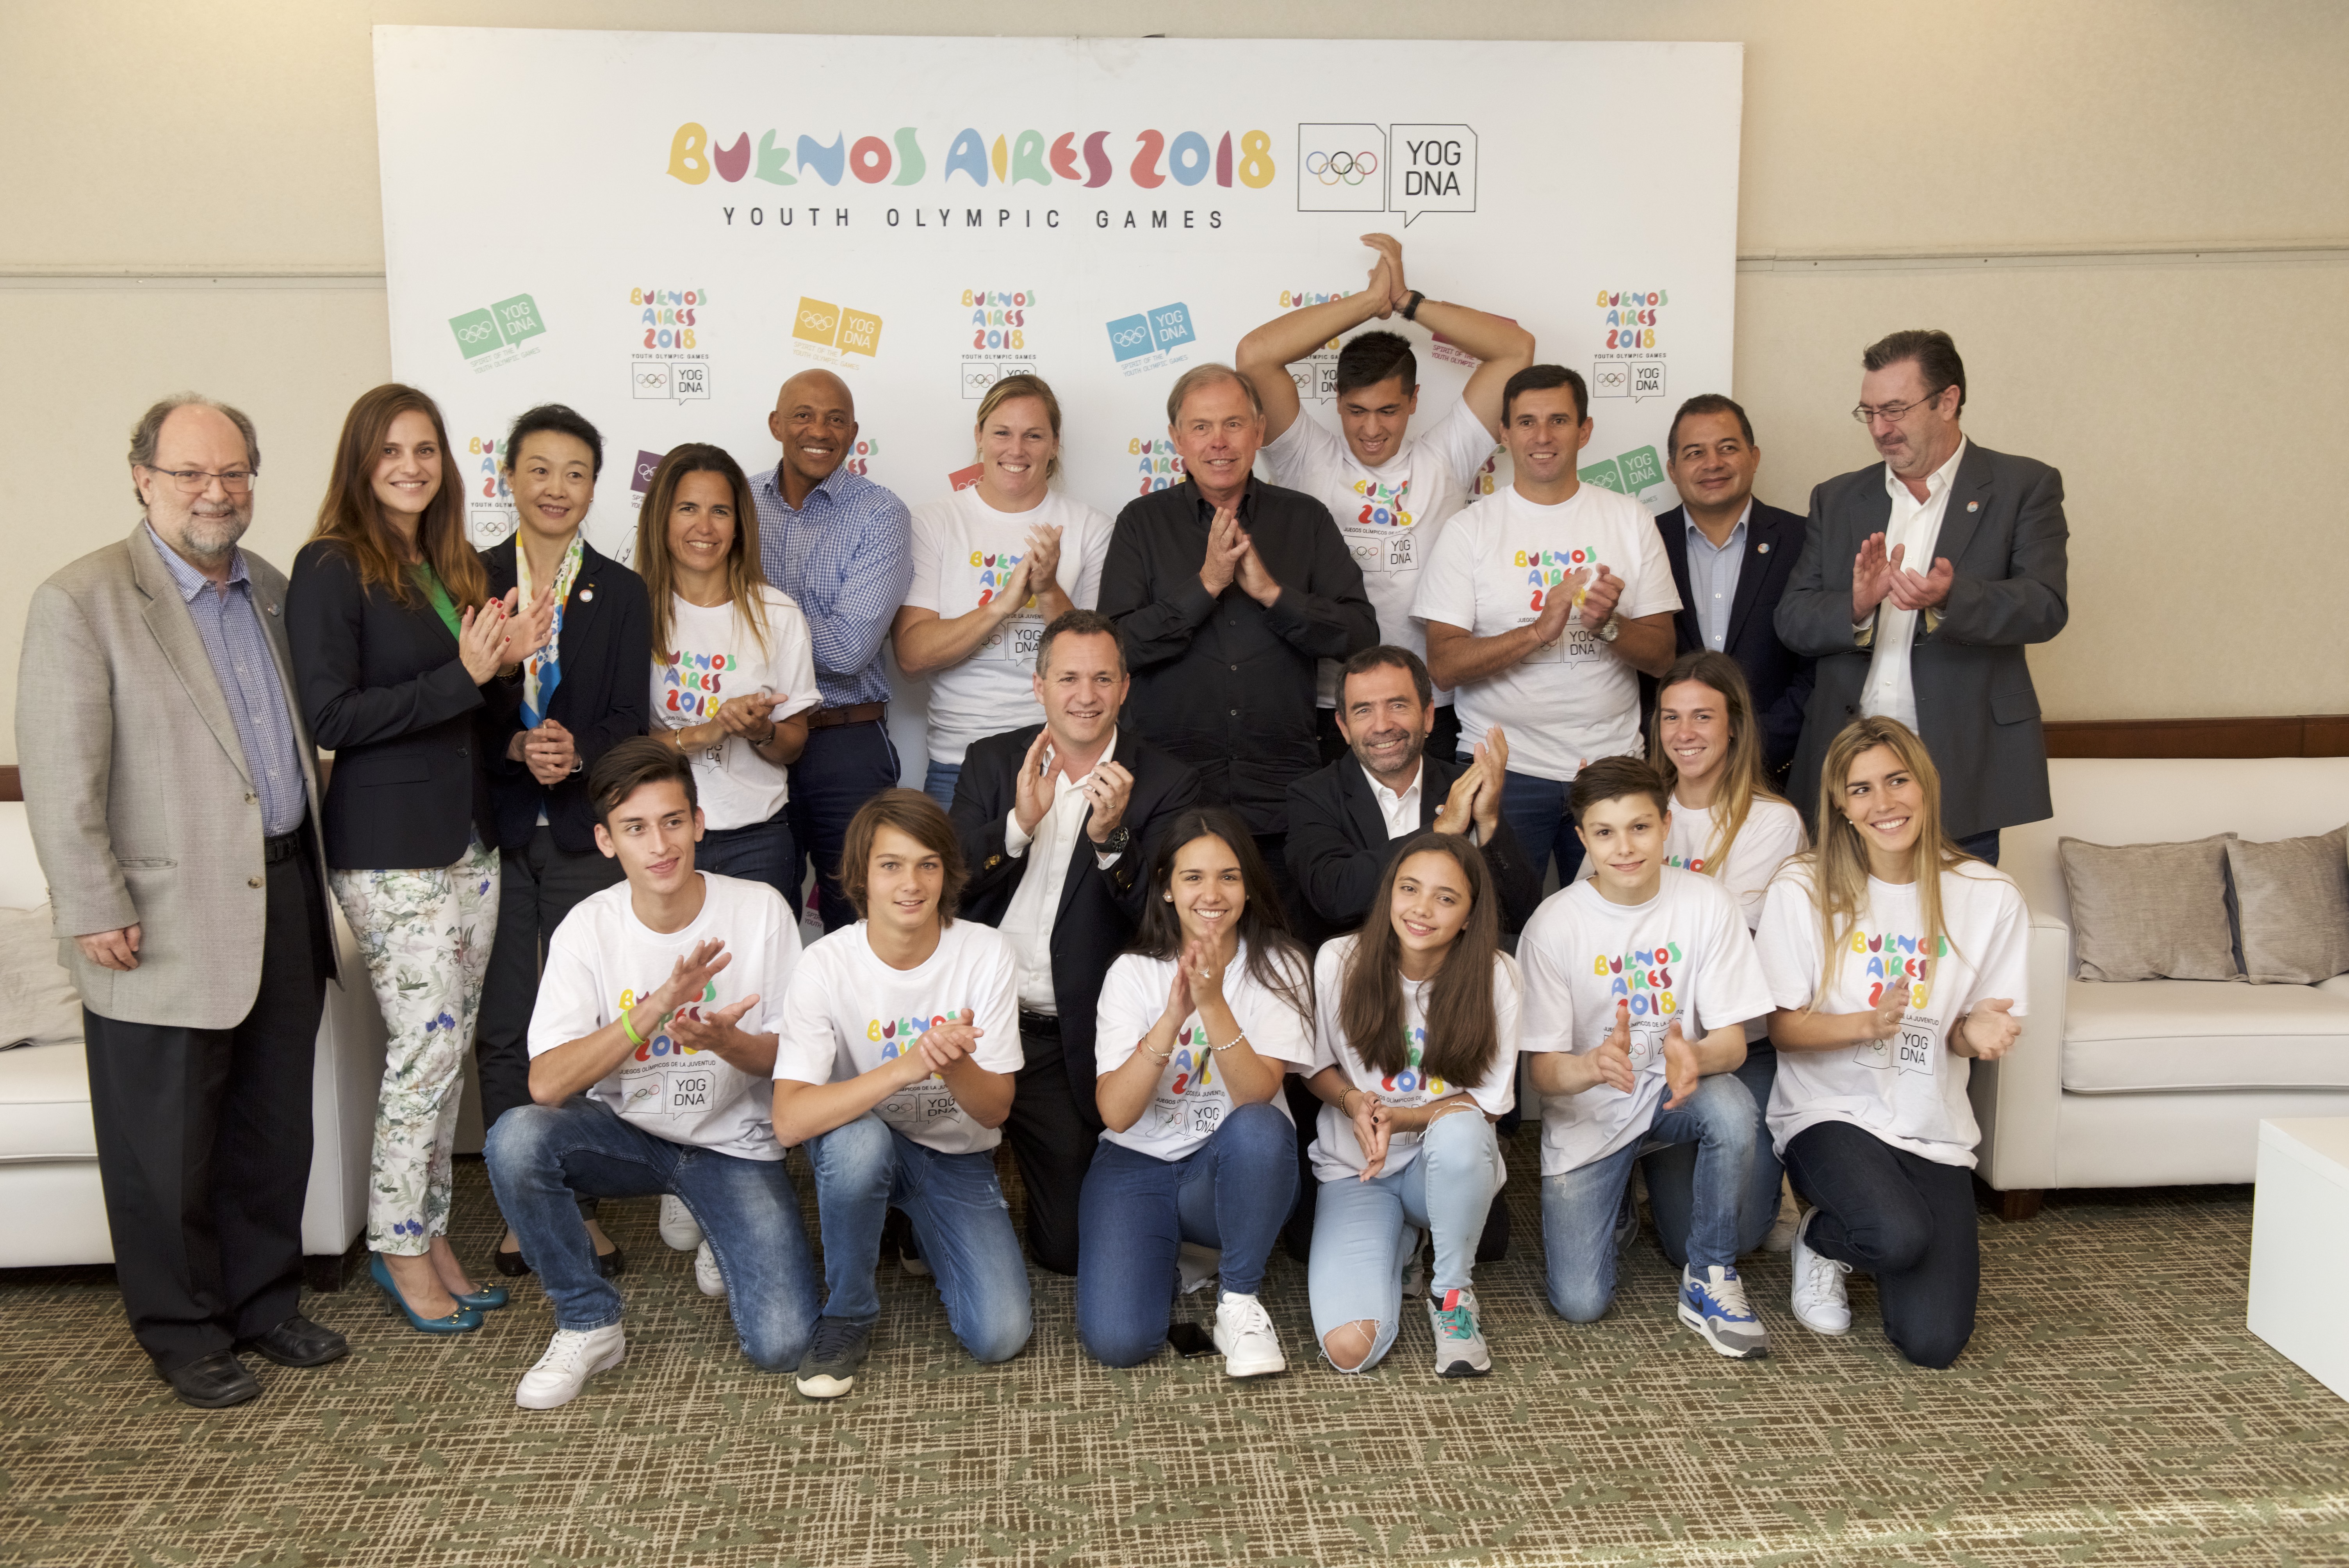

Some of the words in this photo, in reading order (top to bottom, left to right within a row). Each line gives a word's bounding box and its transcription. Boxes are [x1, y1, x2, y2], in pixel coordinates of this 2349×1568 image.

[666, 122, 926, 186] BUENOS
[945, 128, 1112, 188] AIRES
[1130, 129, 1275, 189] 2018
[1406, 141, 1461, 166] YOG
[1406, 171, 1460, 196] DNA
[724, 207, 848, 226] YOUTH
[887, 208, 1060, 228] OLYMPIC
[1096, 210, 1222, 228] GAMES
[630, 287, 707, 306] BUENOS
[961, 289, 1035, 307] BUENOS
[1596, 289, 1668, 308] BUENOS
[501, 302, 530, 320] YOG
[642, 308, 695, 326] AIRES
[972, 309, 1024, 327] AIRES
[1156, 310, 1183, 327] YOG
[1606, 309, 1656, 327] AIRES
[506, 317, 537, 335] DNA
[849, 317, 874, 334] YOG
[1160, 324, 1187, 342] DNA
[644, 328, 696, 349] 2018
[794, 342, 815, 351] SPIRIT
[844, 331, 870, 348] DNA
[973, 329, 1024, 349] 2018
[1606, 328, 1655, 349] 2018
[471, 355, 491, 367] SPIRIT
[503, 348, 515, 356] THE
[1433, 345, 1454, 355] SPIRIT
[473, 364, 493, 374] YOUTH
[494, 354, 519, 367] OLYMPIC
[521, 347, 541, 358] GAMES
[793, 349, 811, 358] YOUTH
[813, 354, 838, 365] OLYMPIC
[840, 361, 859, 370] GAMES
[1121, 360, 1142, 370] SPIRIT
[1123, 369, 1141, 377] YOUTH
[1143, 360, 1167, 372] OLYMPIC
[1169, 355, 1188, 364] GAMES
[1432, 352, 1448, 361] YOUTH
[1451, 357, 1475, 368] OLYMPIC
[679, 370, 702, 380] YOG
[1322, 370, 1337, 380] YO
[1637, 368, 1659, 378] YOG
[679, 382, 703, 392] DNA
[1636, 380, 1659, 390] DNA
[469, 437, 507, 455] BUE
[1128, 438, 1176, 455] BUEN
[1625, 453, 1652, 470] YOG
[1629, 467, 1656, 485] DNA
[1391, 540, 1410, 551] YOG
[970, 551, 1023, 569] BUEN
[1391, 554, 1412, 564] DNA
[1514, 546, 1596, 567] BUENOS
[1015, 642, 1039, 653] DNA
[1570, 643, 1595, 655] DNA
[664, 668, 721, 693] AIRES
[667, 690, 719, 718] 2018
[1594, 941, 1682, 976] BUENOS
[1611, 967, 1672, 998] AIRES
[1913, 1016, 1939, 1026] JUVENTUD
[1902, 1032, 1928, 1049] YOG
[1900, 1047, 1926, 1066] DNA
[642, 1062, 669, 1073] OLÍMPICOS
[675, 1078, 706, 1091] YOG
[674, 1093, 705, 1106] DNA
[928, 1096, 955, 1108] YOG
[928, 1107, 957, 1117] DNA
[1194, 1107, 1220, 1120] YOG
[1196, 1120, 1215, 1134] DNA
